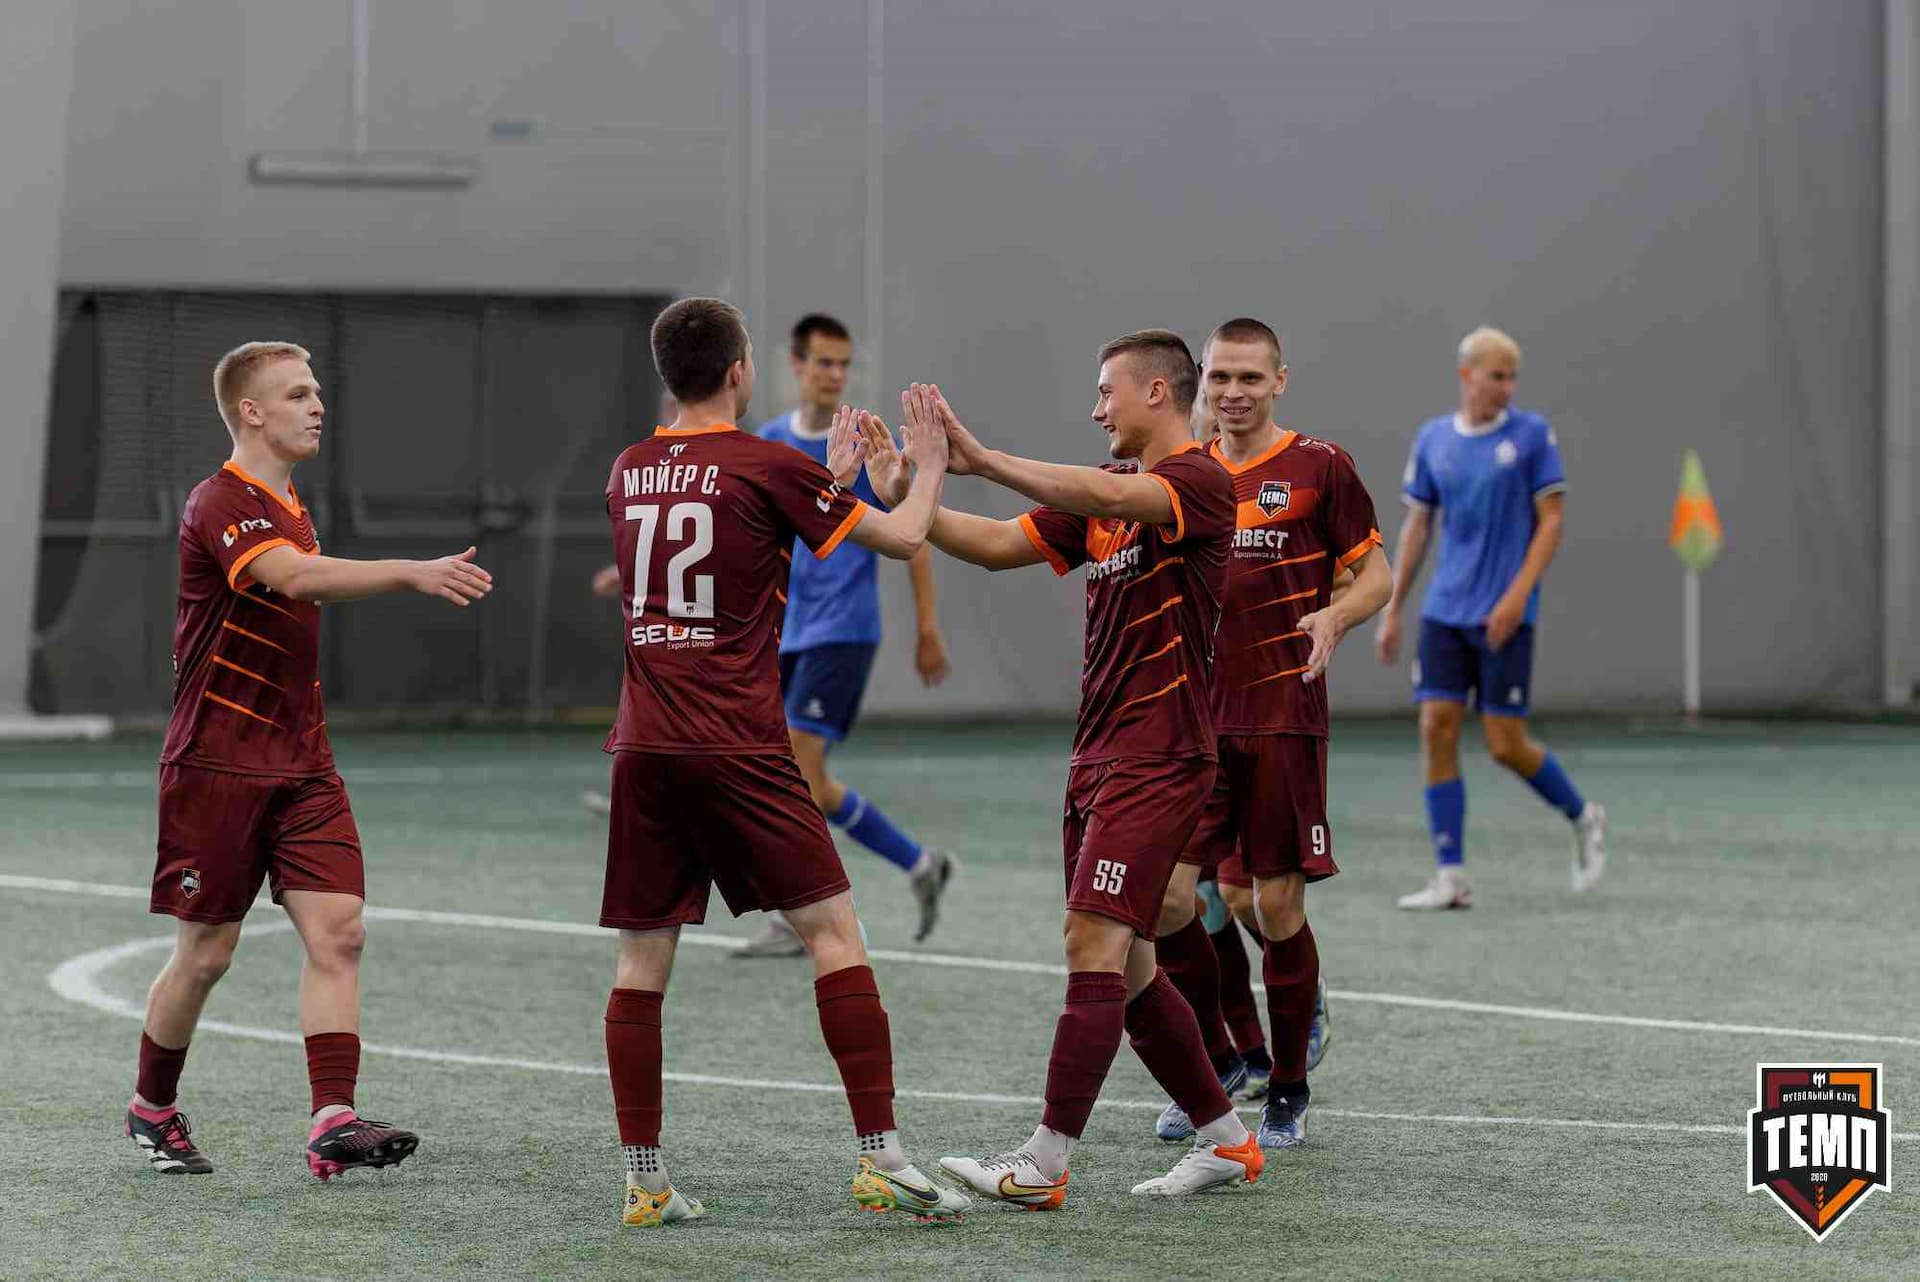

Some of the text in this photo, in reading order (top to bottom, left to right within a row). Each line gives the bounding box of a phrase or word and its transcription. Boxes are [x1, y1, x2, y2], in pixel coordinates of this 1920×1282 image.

[623, 459, 698, 498] МАЙЕР
[1261, 490, 1288, 506] ТЕМП
[625, 502, 715, 619] 72
[667, 639, 715, 651] Export Union
[1312, 824, 1325, 855] 9
[1092, 859, 1127, 896] 55
